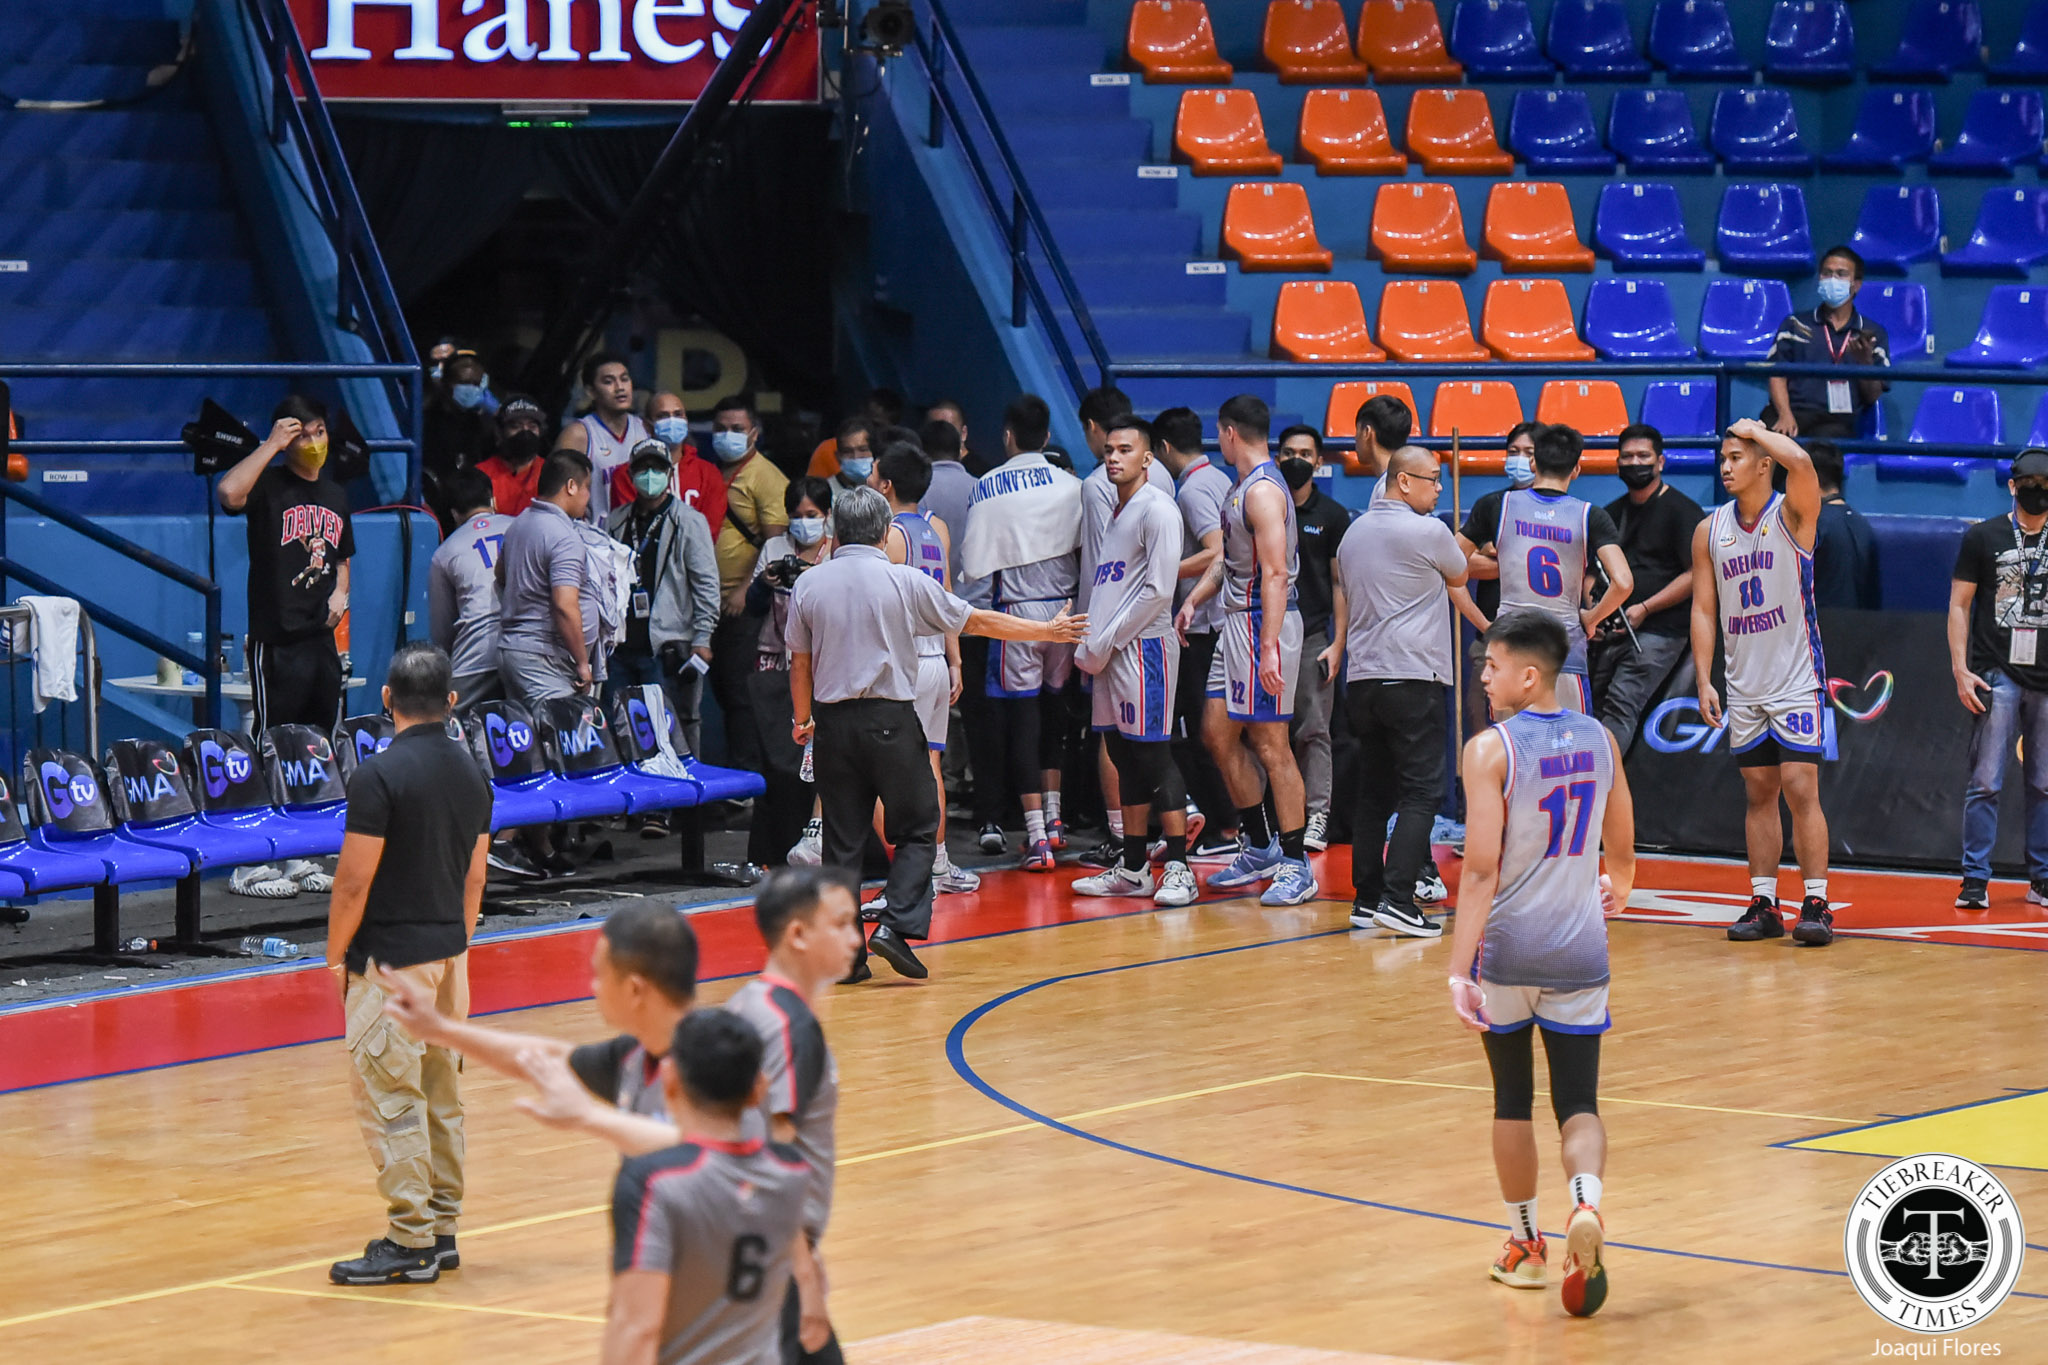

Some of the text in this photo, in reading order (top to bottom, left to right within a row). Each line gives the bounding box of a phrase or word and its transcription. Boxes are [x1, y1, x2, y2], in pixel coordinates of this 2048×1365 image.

[281, 504, 344, 549] DRIVEN
[1515, 519, 1573, 545] TOLENTINO
[1527, 545, 1563, 598] 6
[1119, 701, 1136, 725] 10
[1231, 680, 1245, 704] 22
[1539, 780, 1596, 859] 17
[727, 1235, 769, 1302] 6
